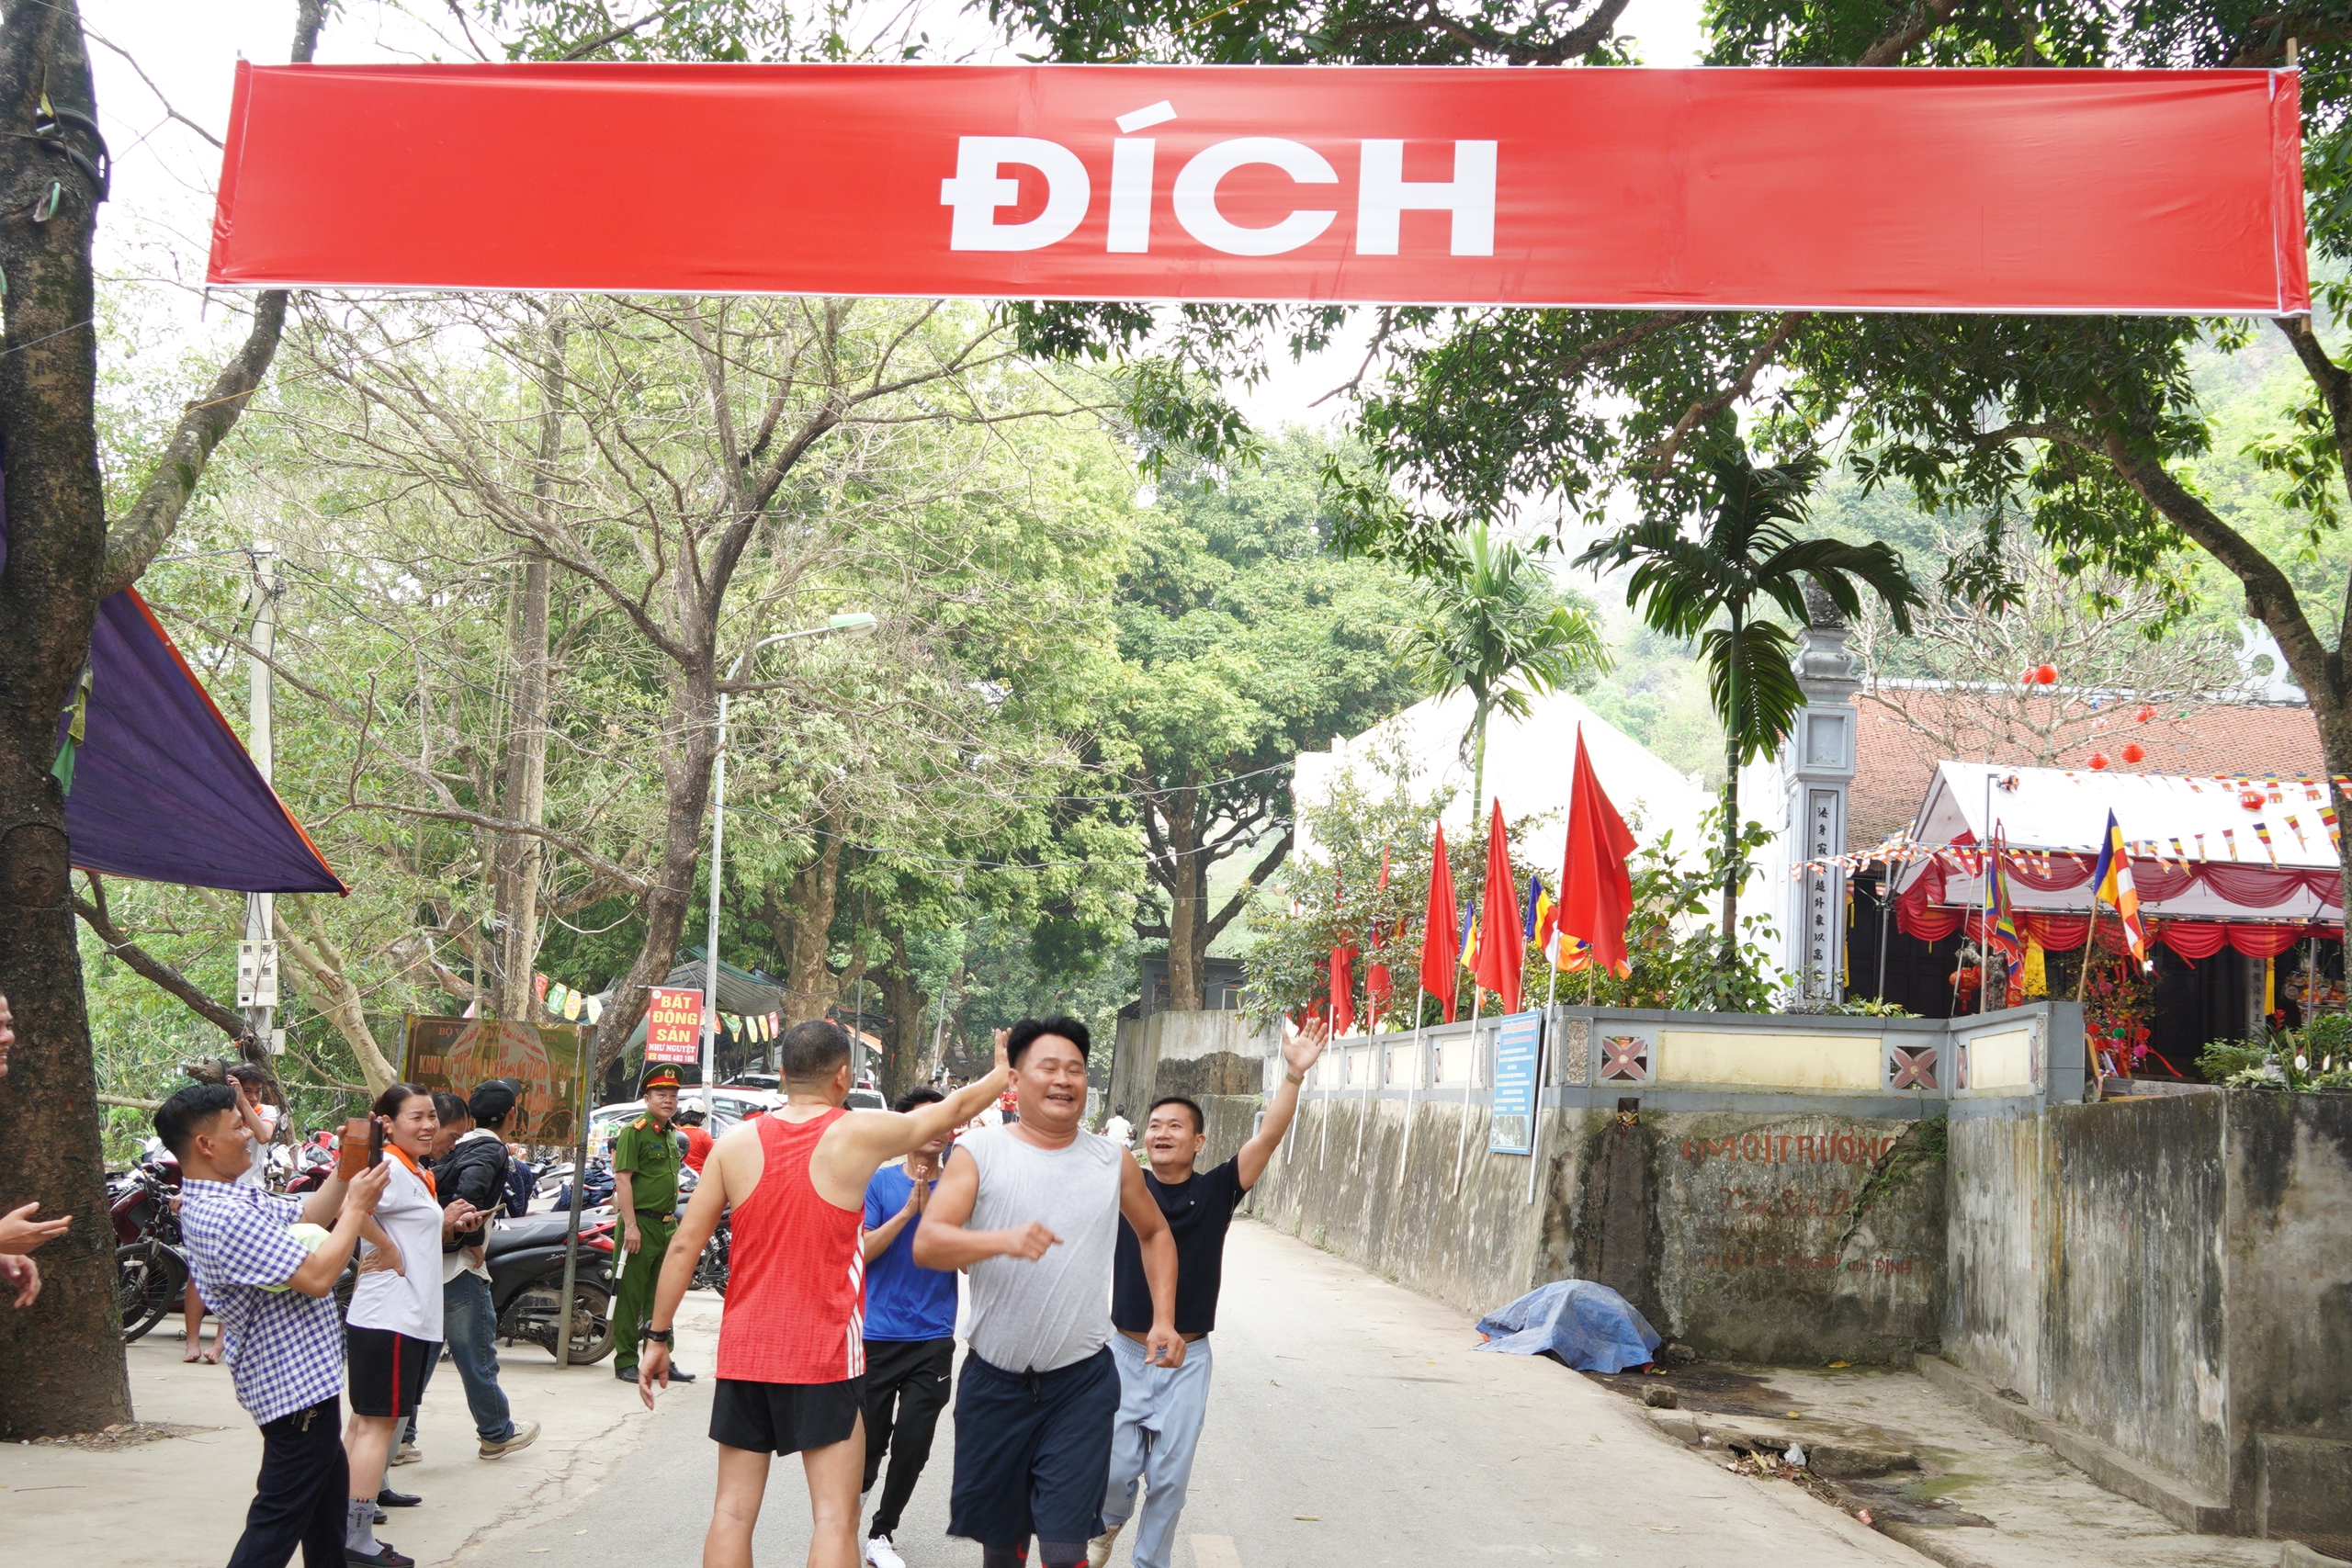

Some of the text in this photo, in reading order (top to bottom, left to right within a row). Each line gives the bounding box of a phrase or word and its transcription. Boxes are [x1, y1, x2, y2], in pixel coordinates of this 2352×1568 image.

[940, 99, 1498, 257] ĐÍCH
[661, 992, 693, 1010] BẤT
[652, 1009, 698, 1027] ĐỘNG
[656, 1025, 691, 1043] SẢN
[649, 1043, 696, 1055] NHƯ NGUYỆT
[418, 1055, 441, 1075] KHU
